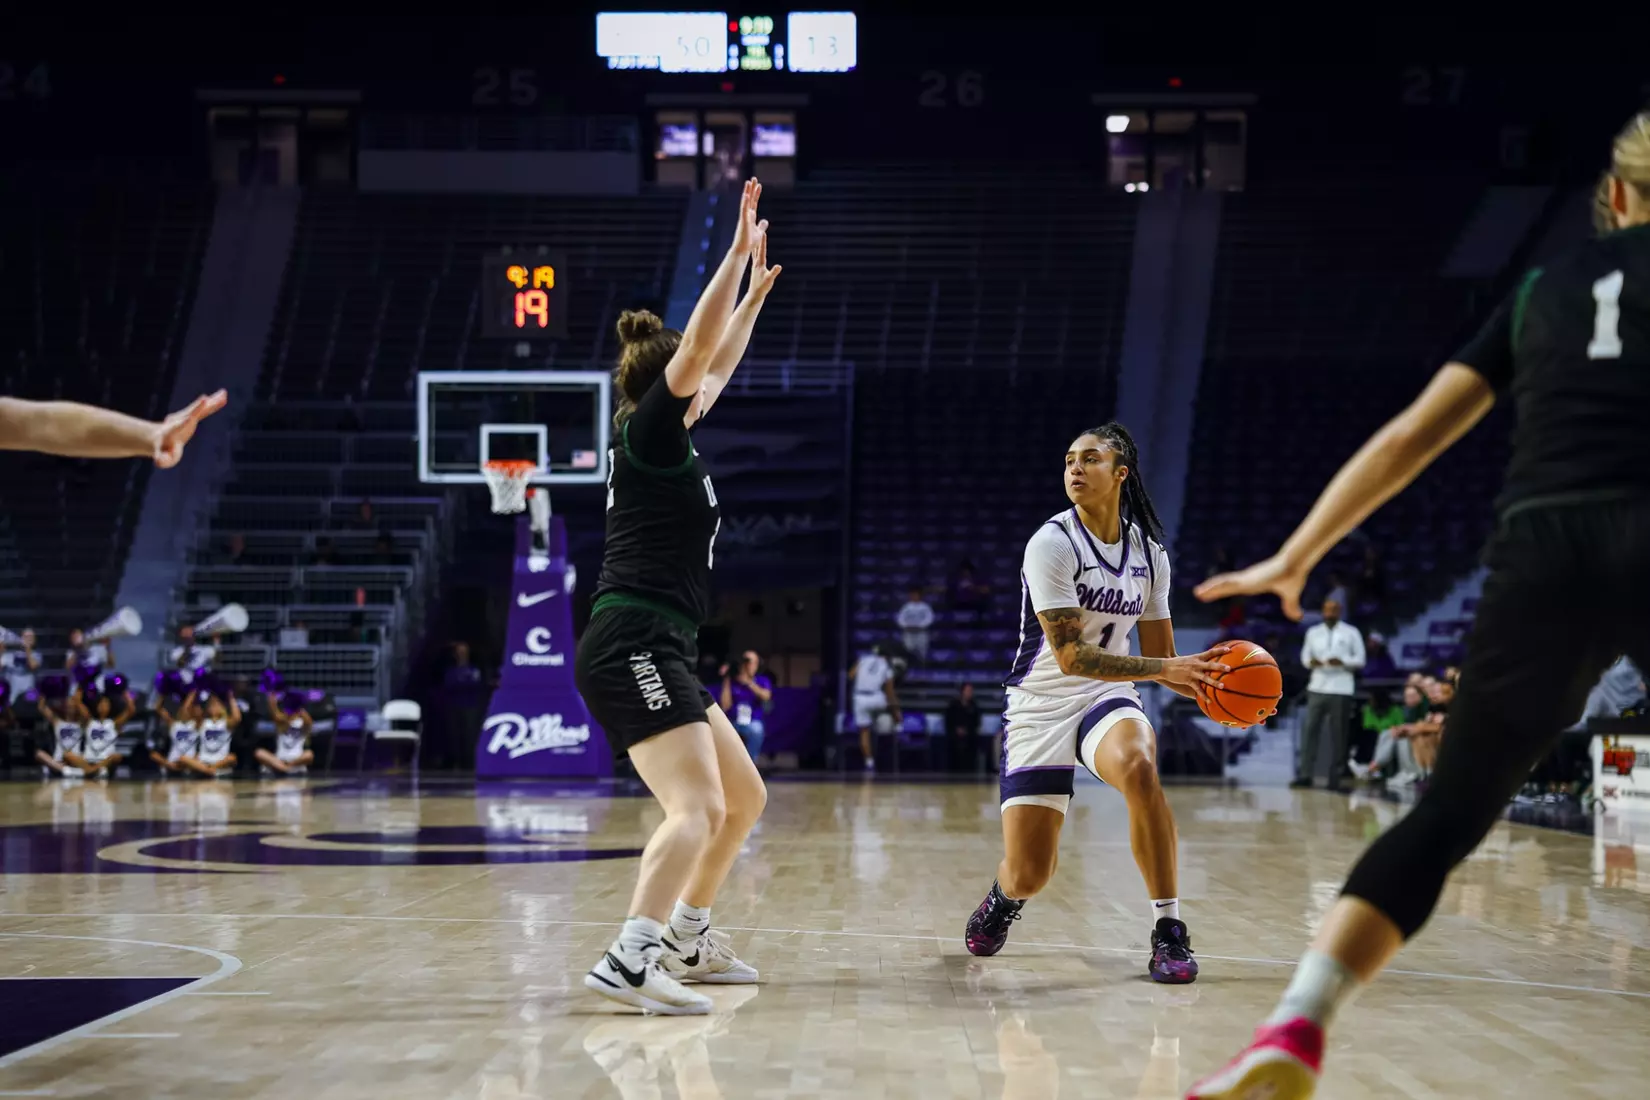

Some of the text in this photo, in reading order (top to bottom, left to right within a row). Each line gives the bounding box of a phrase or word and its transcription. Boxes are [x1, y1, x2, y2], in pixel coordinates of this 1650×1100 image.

[471, 66, 538, 106] 25
[918, 68, 985, 107] 26
[1400, 66, 1465, 106] 27
[506, 265, 555, 289] 9:19
[515, 289, 548, 328] 19
[1587, 268, 1624, 359] 1
[1099, 622, 1116, 649] 1
